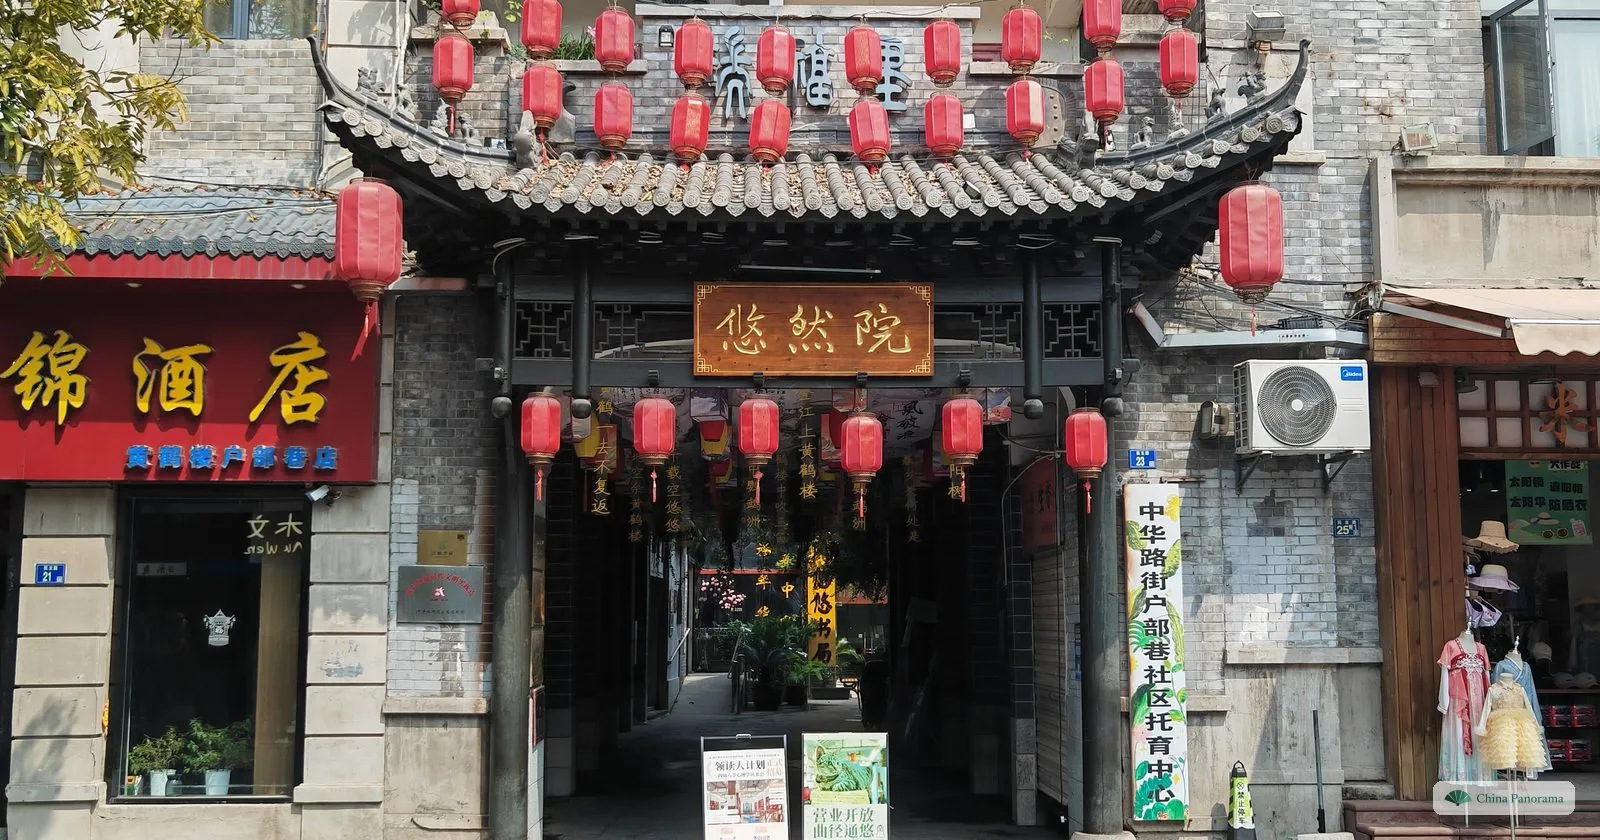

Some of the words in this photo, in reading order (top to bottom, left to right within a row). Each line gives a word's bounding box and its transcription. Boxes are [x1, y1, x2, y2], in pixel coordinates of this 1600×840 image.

[716, 302, 912, 355] 悠然院
[0, 330, 331, 425] 锦酒店
[1342, 369, 1363, 378] Midea
[125, 444, 339, 471] 黄鹤楼户部巷店
[1136, 456, 1145, 466] 23
[42, 571, 52, 582] 21
[1138, 501, 1175, 803] 中华路街户部巷社区托育中心
[715, 759, 766, 772] 领读人计划
[812, 807, 875, 823] 营业开放
[1237, 791, 1246, 825] 禁止停车
[812, 823, 875, 839] 曲径通悠
